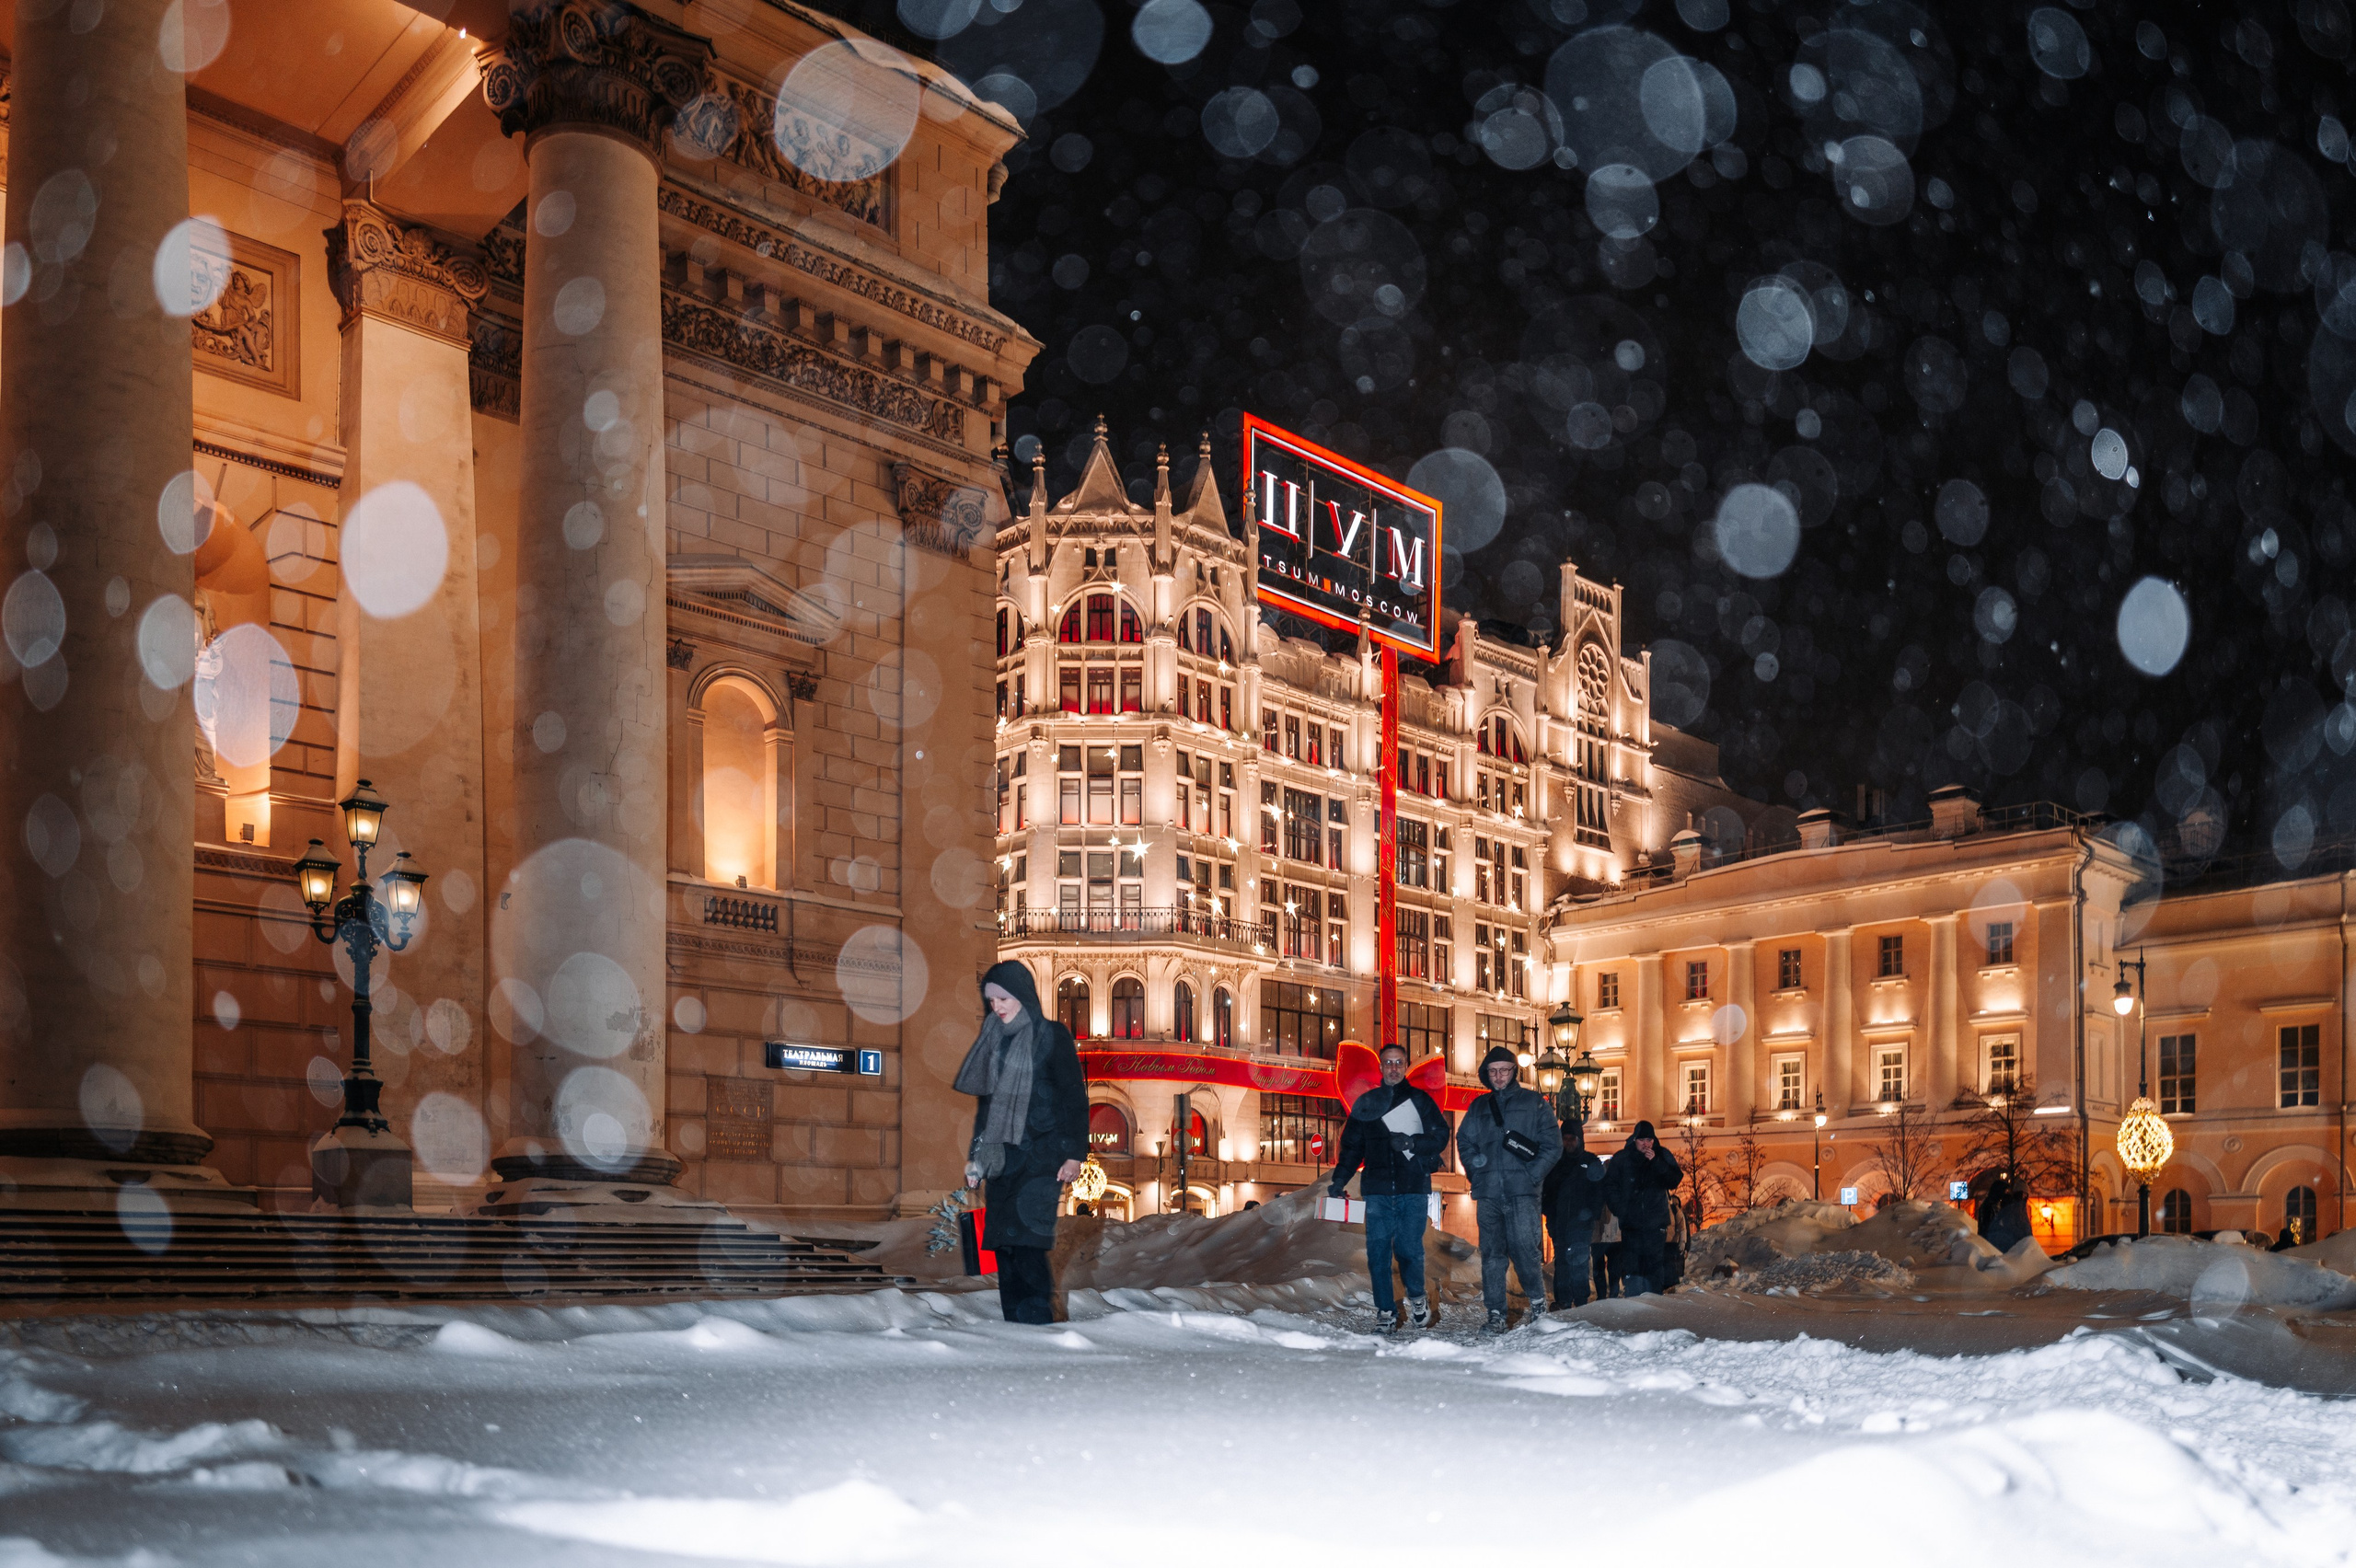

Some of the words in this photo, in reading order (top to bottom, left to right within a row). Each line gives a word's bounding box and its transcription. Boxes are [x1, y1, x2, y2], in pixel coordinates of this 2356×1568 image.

[1264, 554, 1319, 586] TSUM
[1334, 582, 1418, 624] MOSCOW
[1381, 815, 1394, 849] Year
[1381, 851, 1392, 881] New
[1382, 882, 1394, 923] Happy
[783, 1049, 843, 1063] ТЕАТРАЛЬНАЯ
[867, 1054, 875, 1071] 1
[1117, 1055, 1176, 1073] Новым
[1177, 1056, 1216, 1076] Годом
[1253, 1067, 1277, 1089] Happy
[1276, 1069, 1296, 1087] New
[1299, 1072, 1322, 1091] Year
[1844, 1189, 1854, 1204] P
